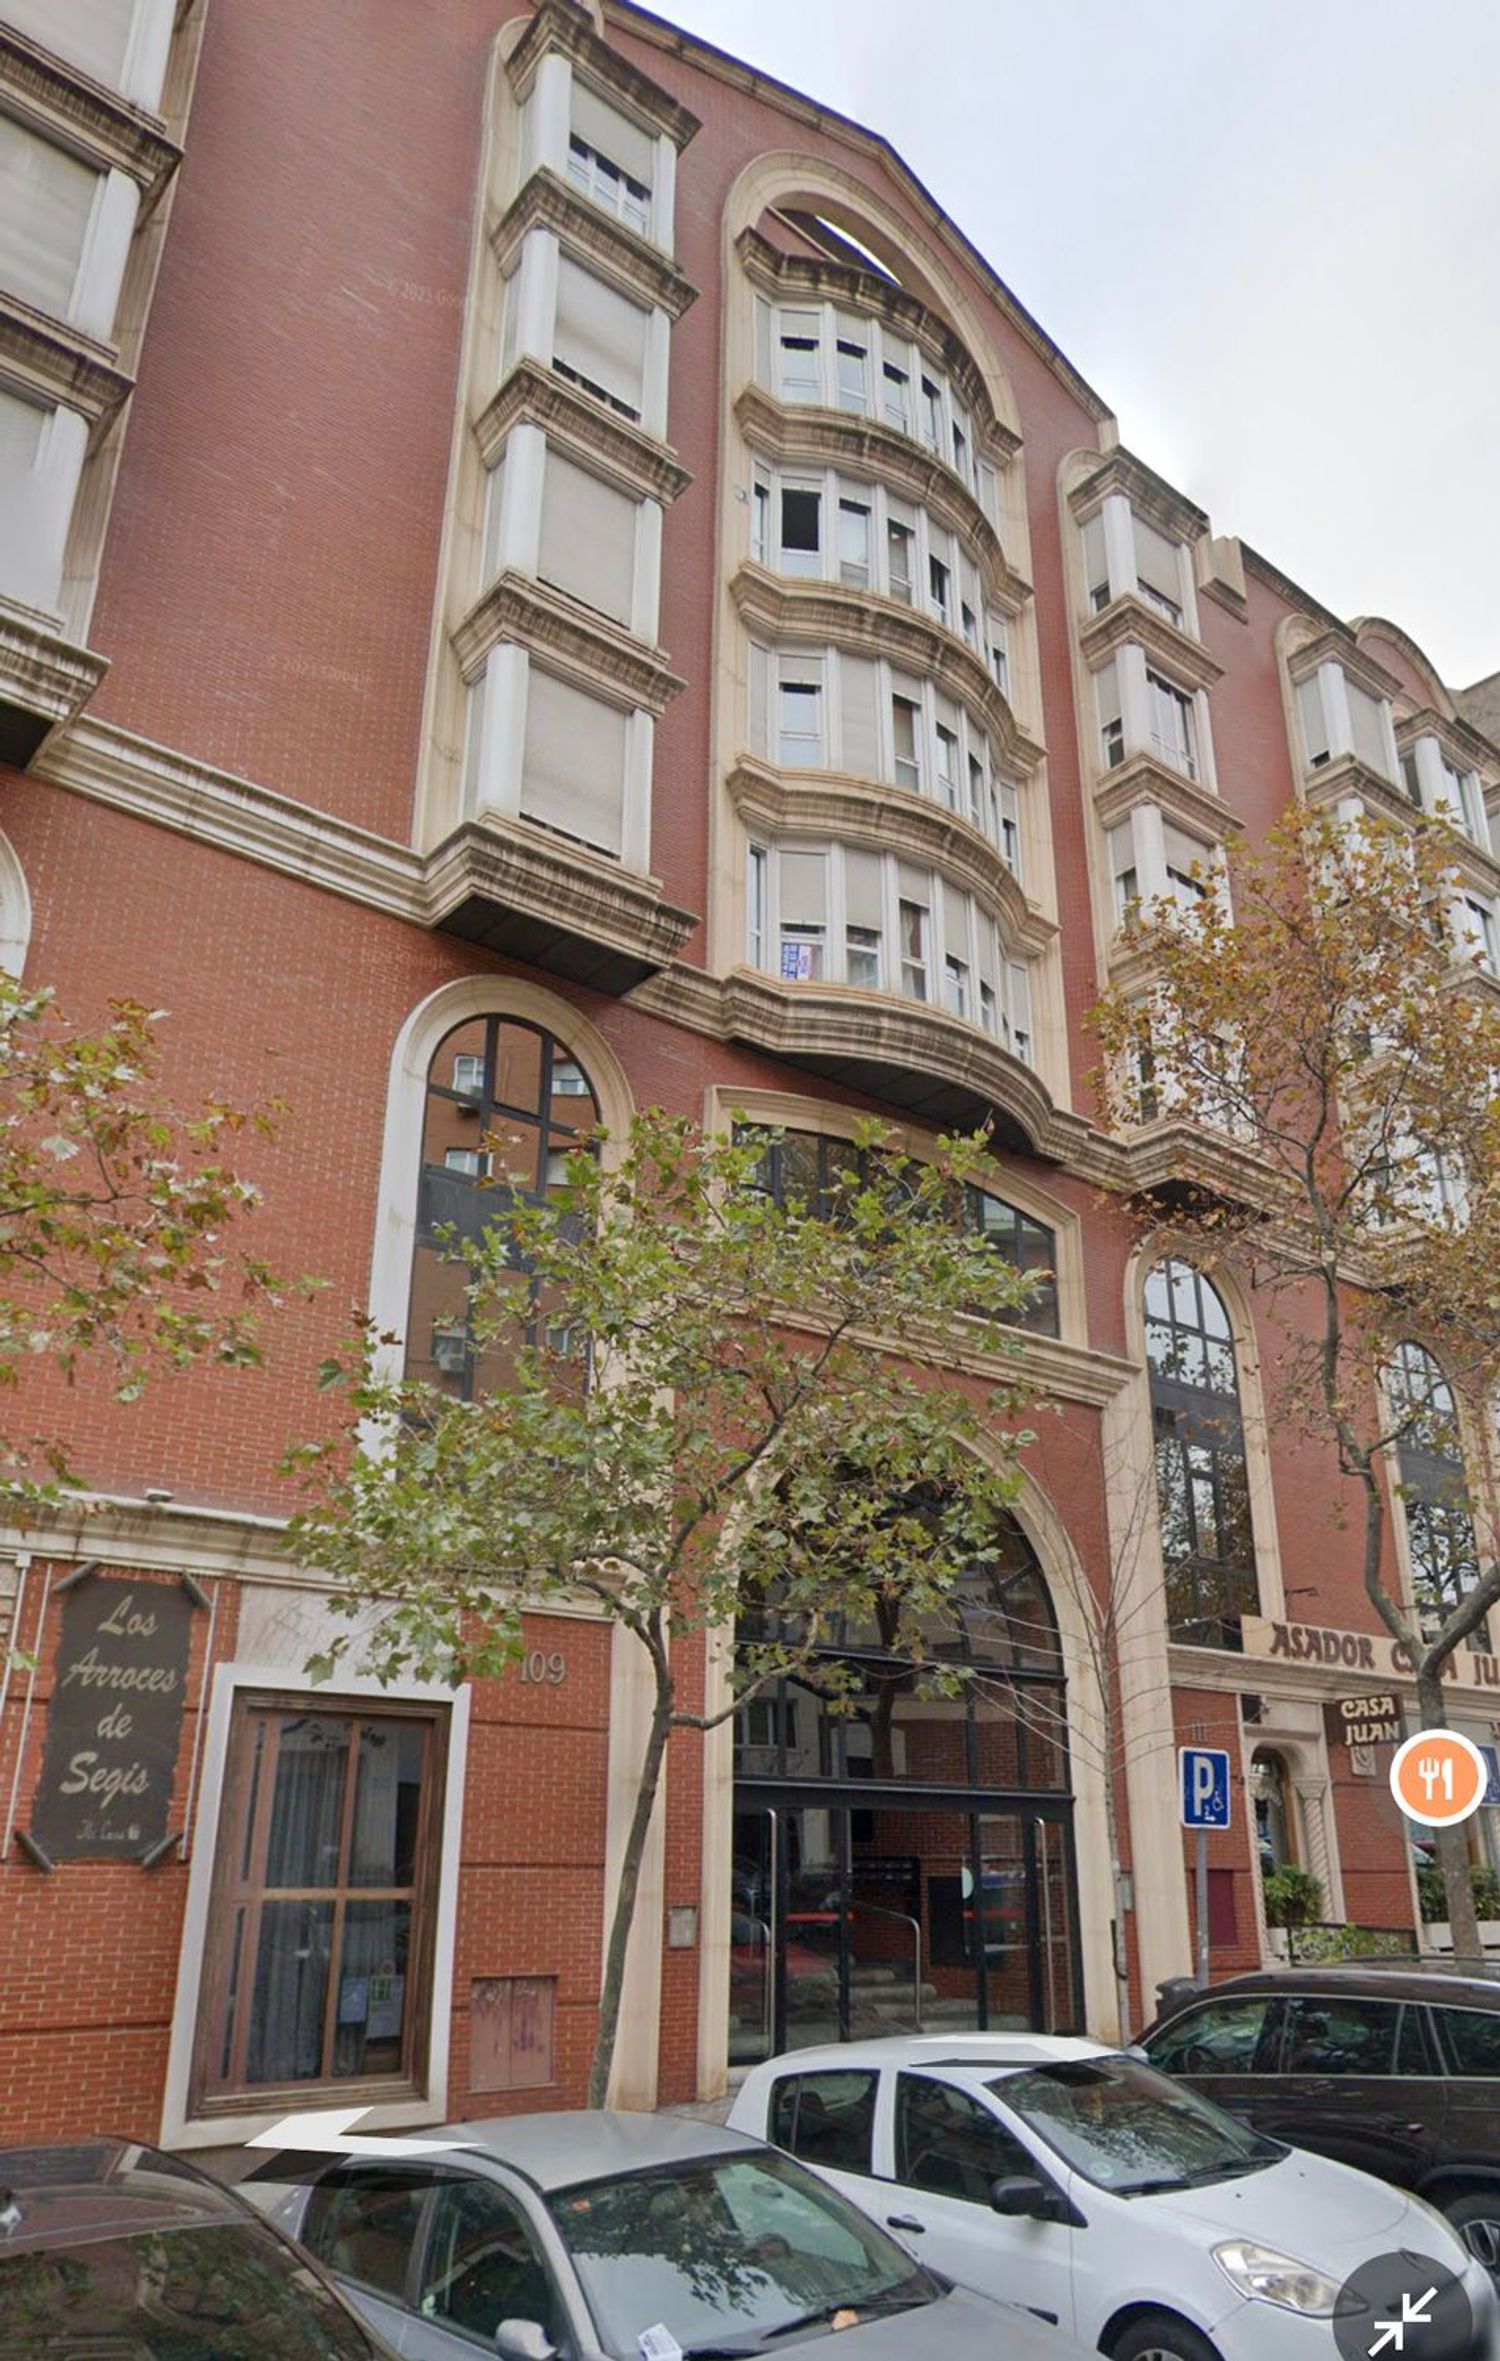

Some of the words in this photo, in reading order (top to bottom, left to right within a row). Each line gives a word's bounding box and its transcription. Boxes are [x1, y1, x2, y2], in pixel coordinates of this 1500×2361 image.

[98, 1594, 158, 1636] Los
[1269, 1621, 1376, 1670] ASADOR
[61, 1647, 178, 1693] Arroces
[520, 1650, 565, 1685] 109
[97, 1703, 133, 1740] de
[1341, 1696, 1395, 1719] CASA
[1345, 1721, 1399, 1746] JUAN
[60, 1751, 150, 1809] Segis
[1193, 1755, 1215, 1817] P
